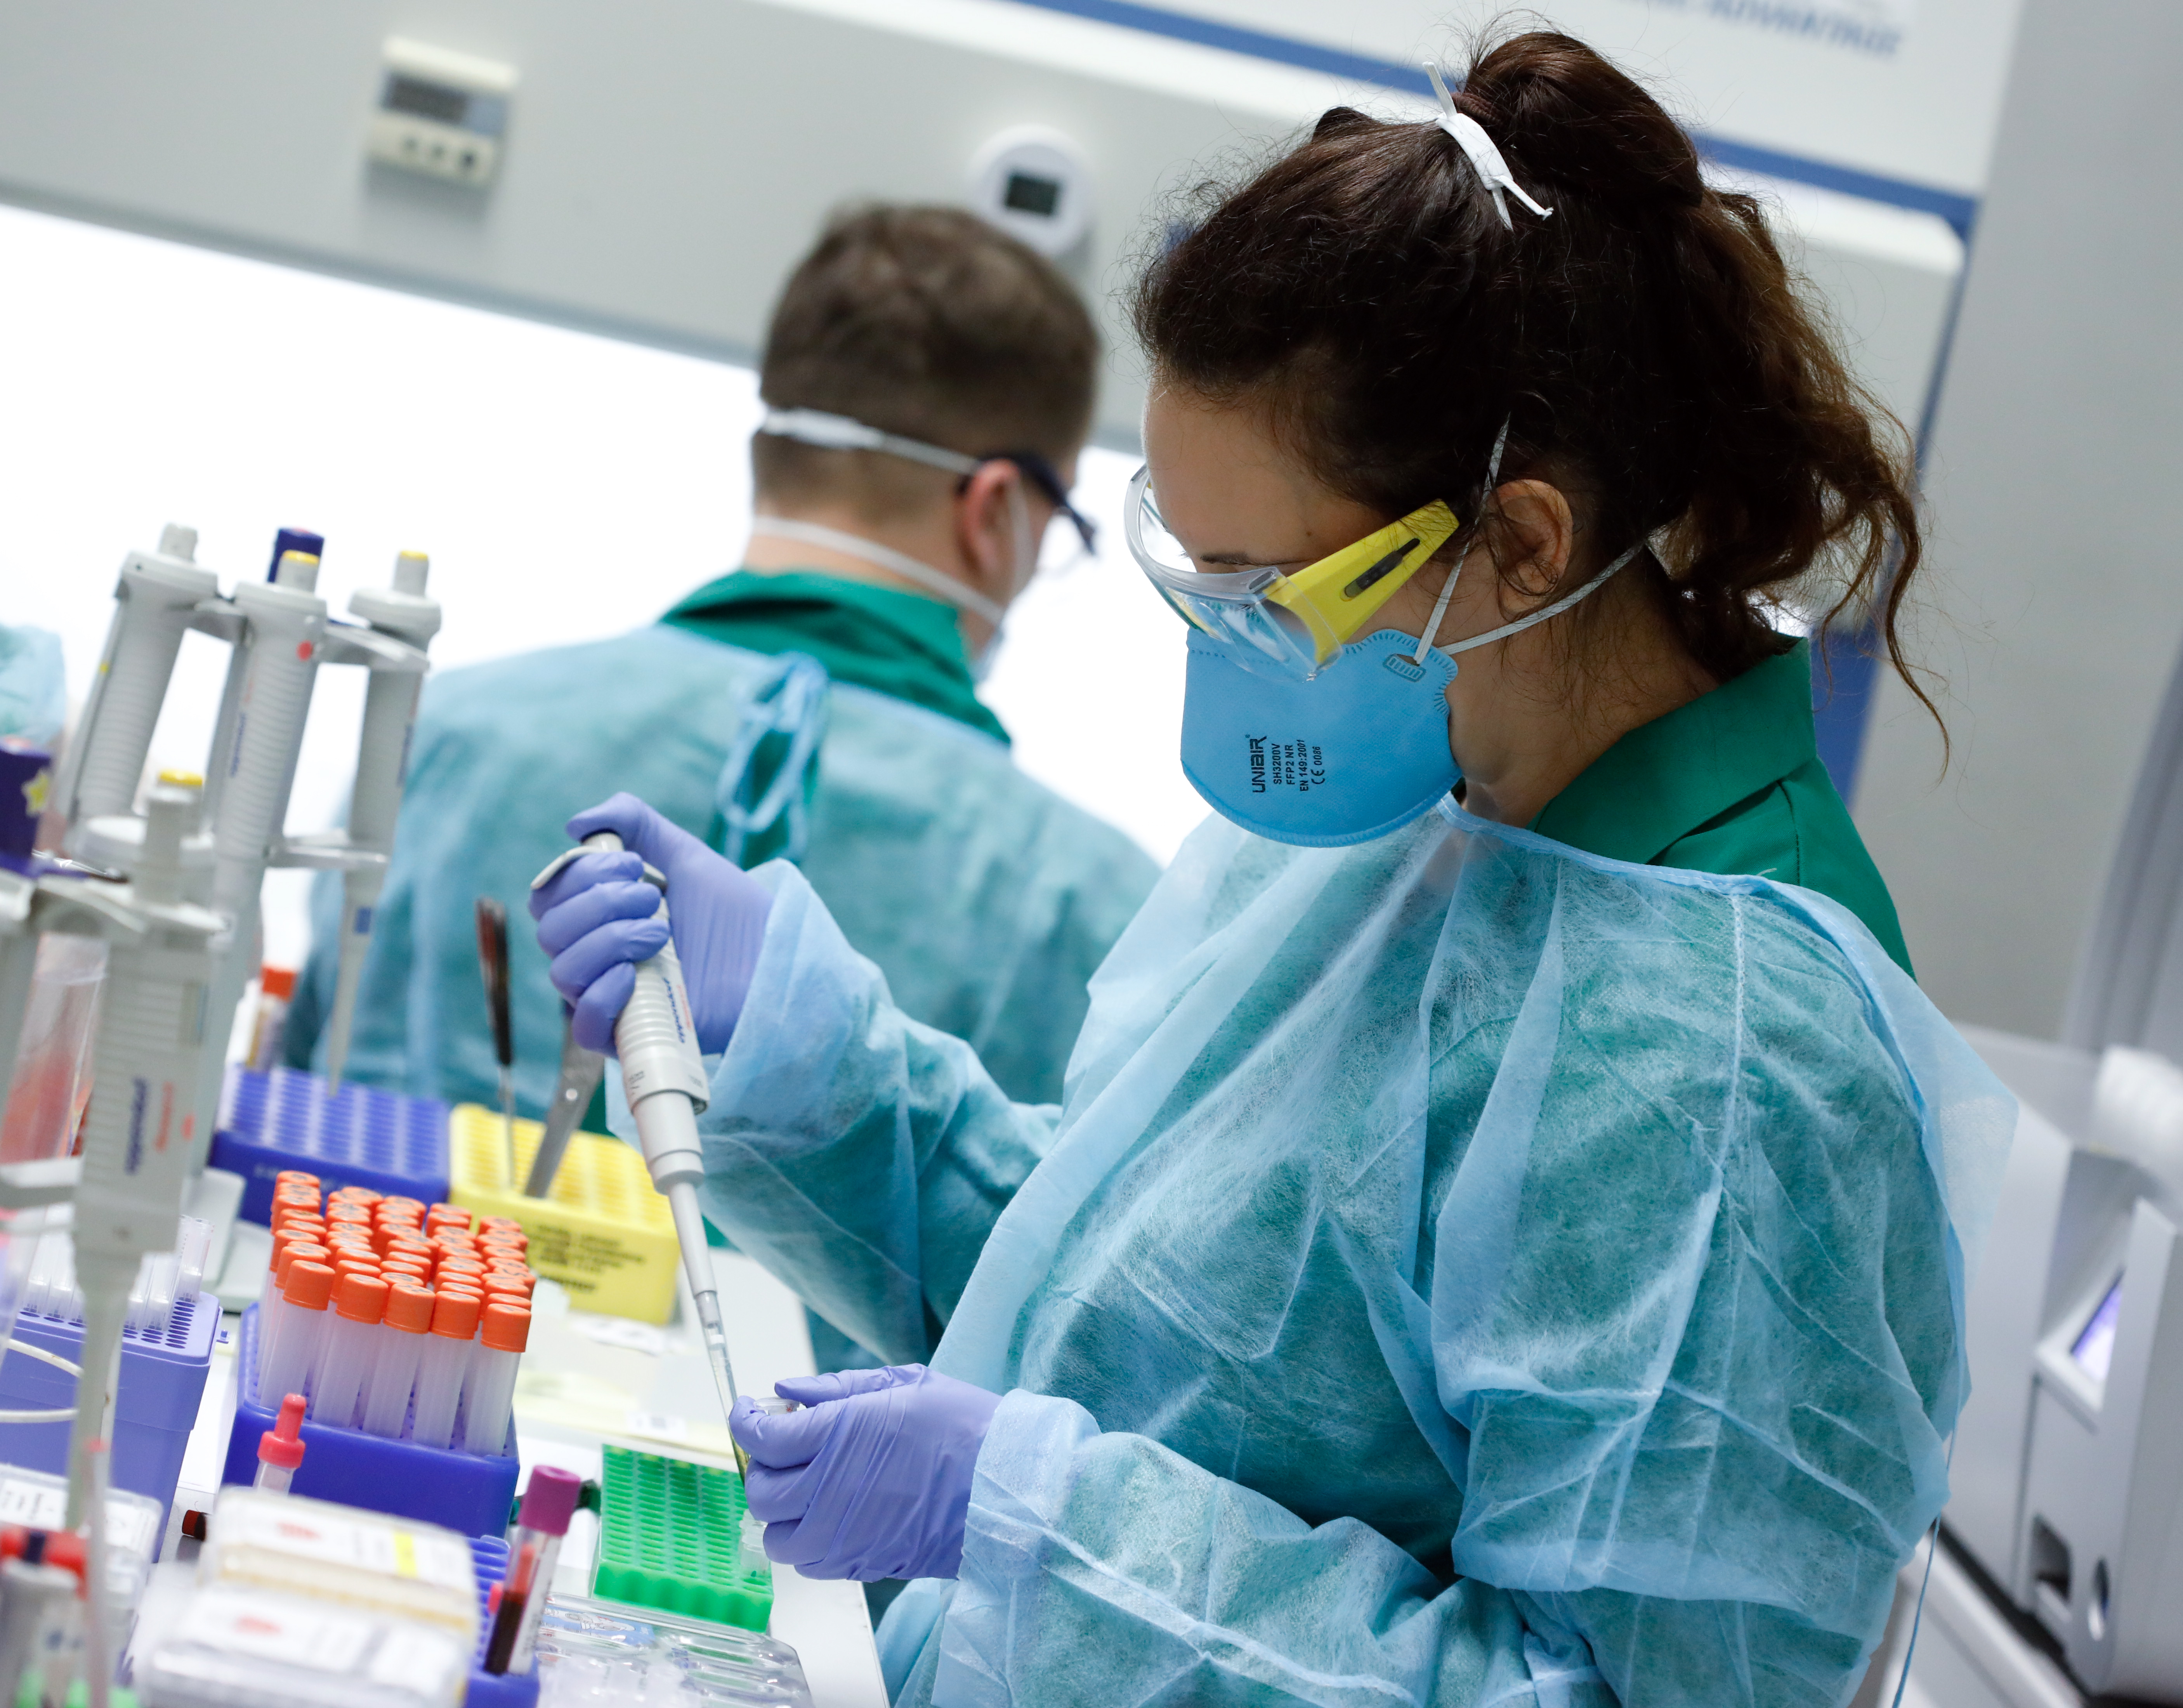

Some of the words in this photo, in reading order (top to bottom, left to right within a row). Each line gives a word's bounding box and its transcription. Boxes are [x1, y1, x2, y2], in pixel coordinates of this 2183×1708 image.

[1284, 744, 1295, 759] NR
[1296, 739, 1308, 777] 149:2001
[1312, 746, 1323, 766] 0086
[1271, 743, 1282, 785] SH3200V
[1286, 761, 1295, 785] FFP2
[1300, 779, 1309, 791] EN
